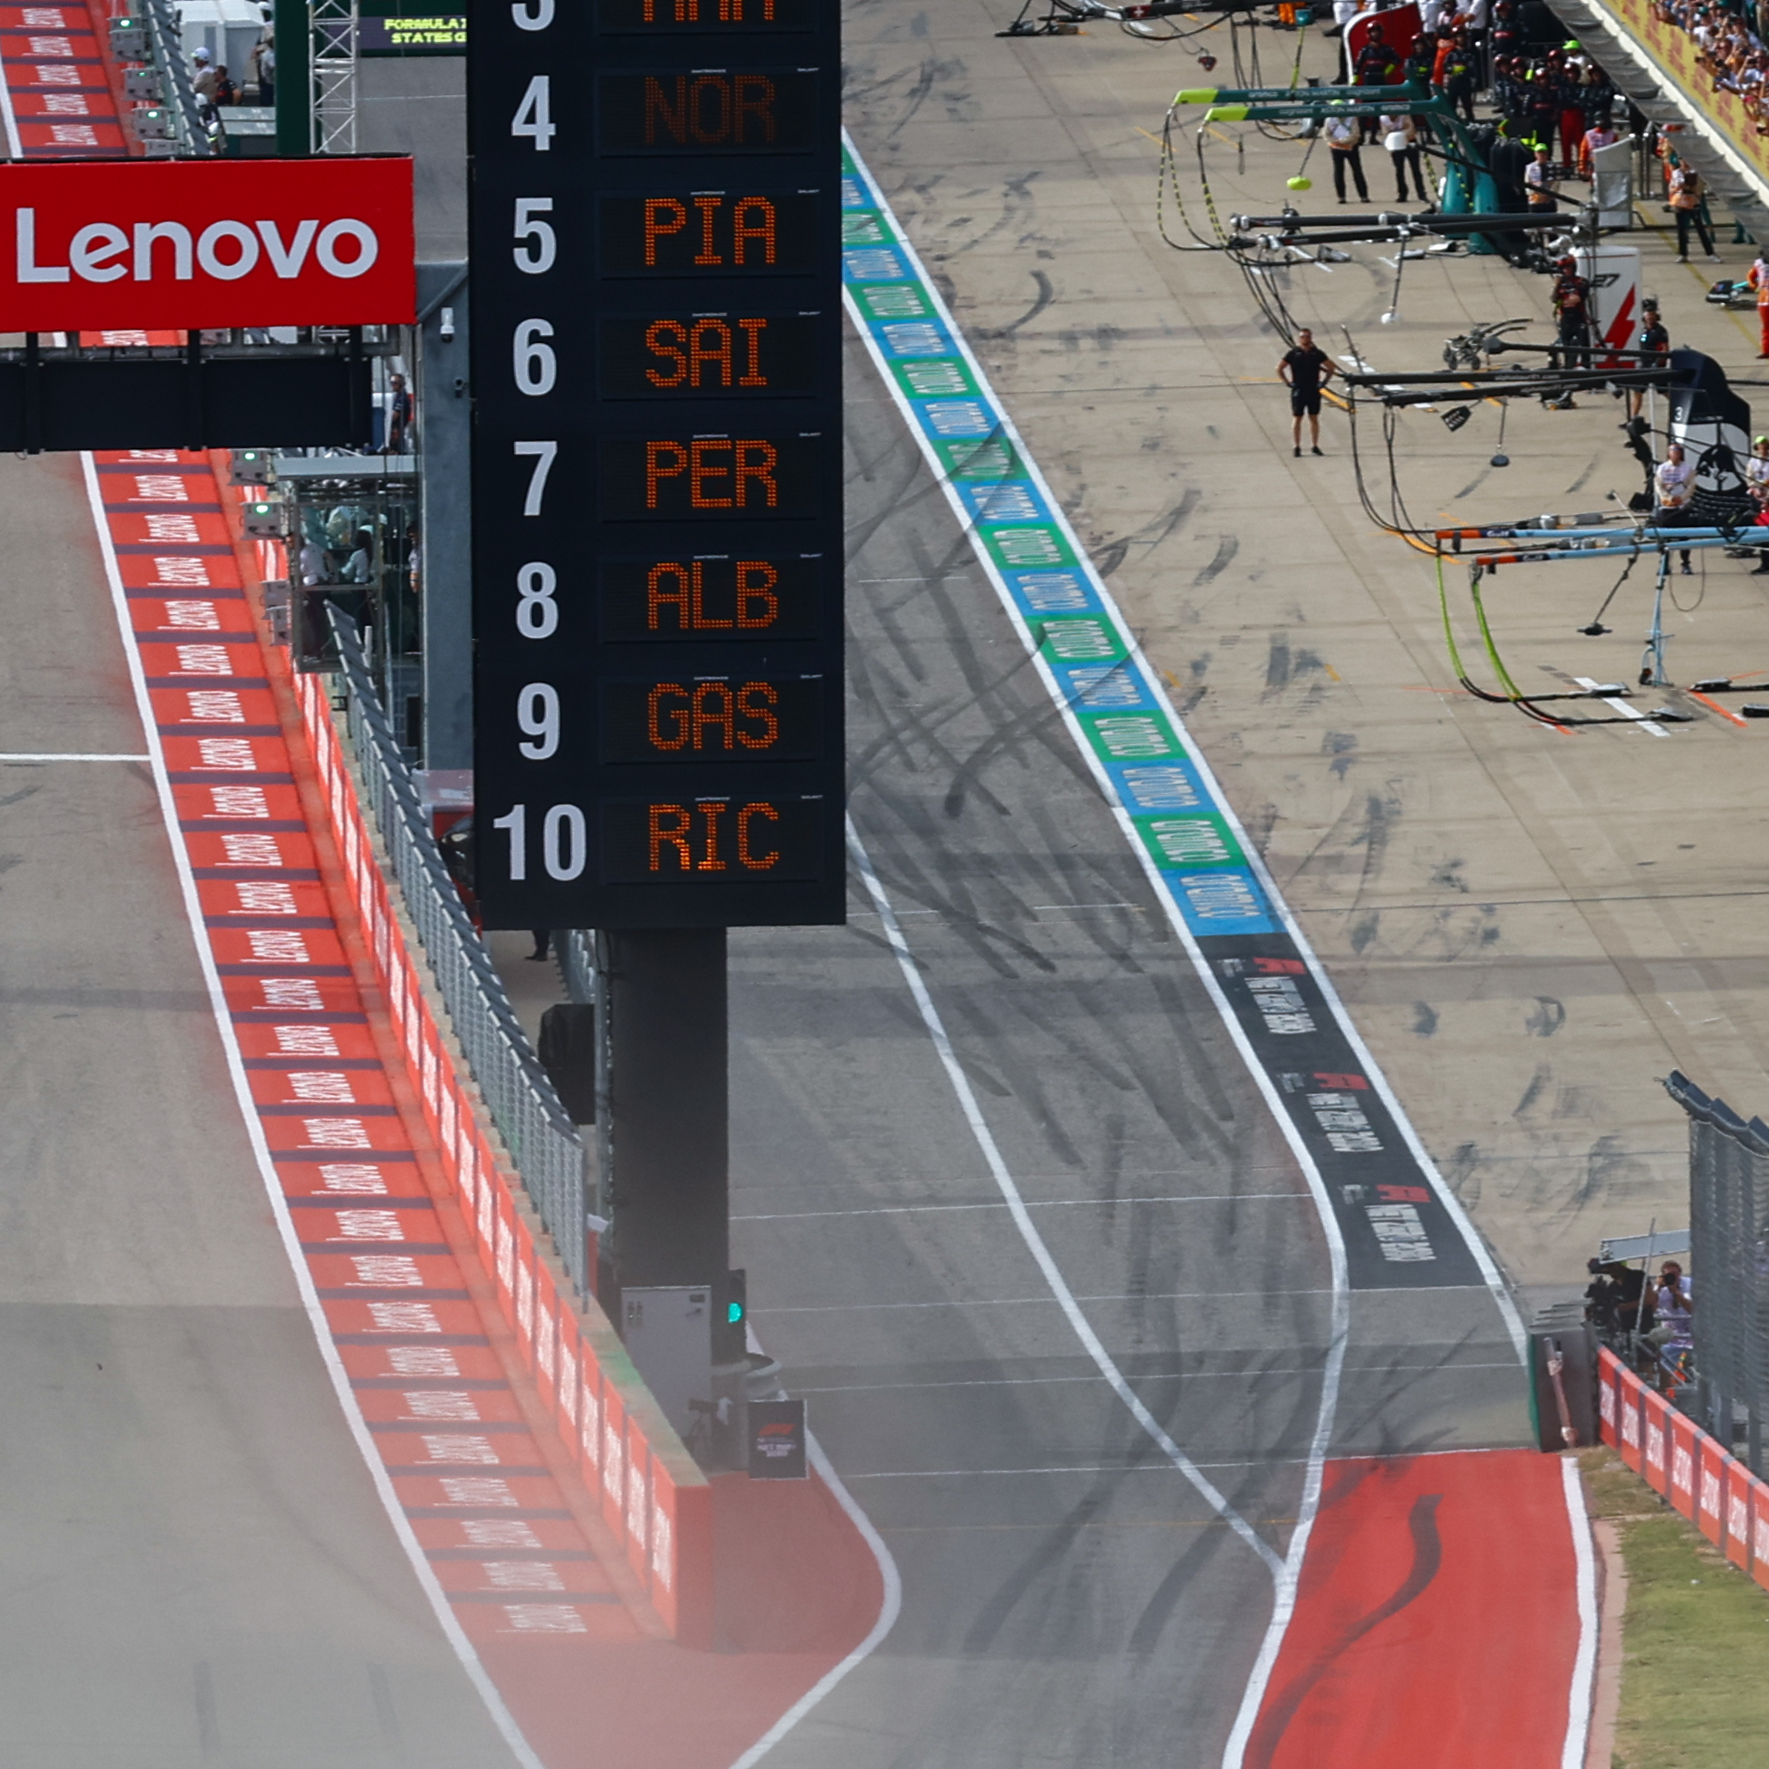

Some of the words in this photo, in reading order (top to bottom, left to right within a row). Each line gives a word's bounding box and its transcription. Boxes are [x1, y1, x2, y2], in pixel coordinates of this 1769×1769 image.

[384, 18, 459, 30] FORMULA
[391, 32, 453, 43] STATES
[512, 75, 556, 151] 4
[644, 75, 775, 143] NOR
[16, 207, 378, 283] Lenovo
[513, 197, 556, 274] 5
[644, 196, 776, 266] PIA
[514, 318, 556, 396] 6
[645, 318, 768, 387] SAI
[514, 441, 557, 516] 7
[646, 439, 777, 508] PER
[516, 562, 558, 639] 8
[647, 561, 778, 629] ALB
[517, 682, 559, 760] 9
[648, 681, 779, 750] GAS
[494, 804, 586, 881] 10
[649, 802, 780, 871] RIC
